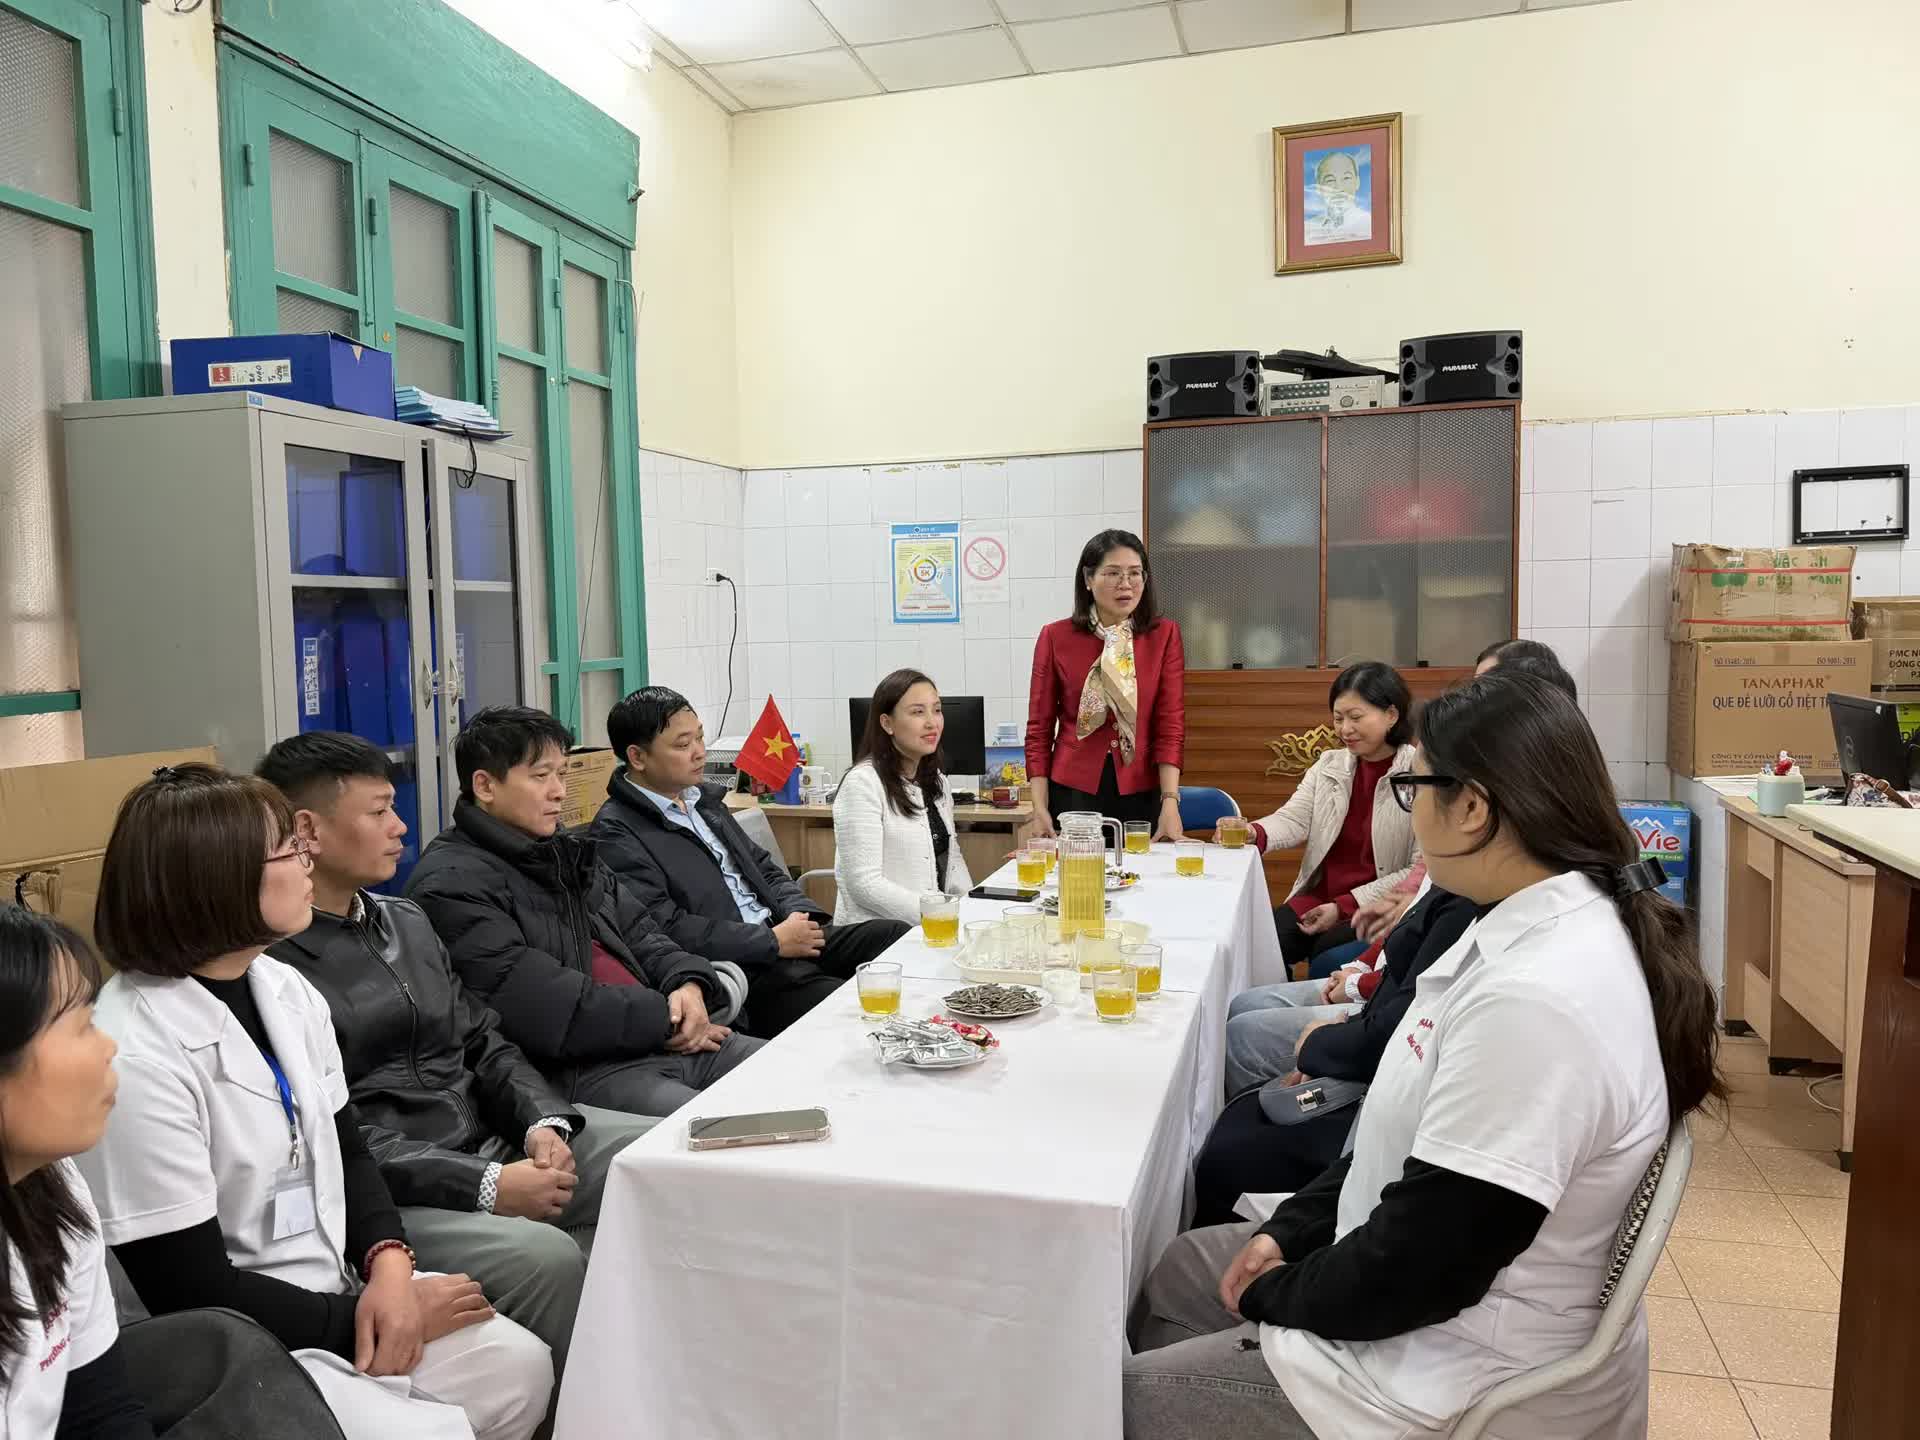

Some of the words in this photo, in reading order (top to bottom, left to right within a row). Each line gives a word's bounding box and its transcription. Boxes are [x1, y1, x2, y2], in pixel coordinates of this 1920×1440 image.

[1442, 363, 1478, 372] PARAMAX
[1185, 381, 1218, 389] PARAMAX
[1740, 678, 1825, 689] TANAPHAR
[1712, 696, 1734, 710] QUE
[1634, 828, 1681, 851] Vie
